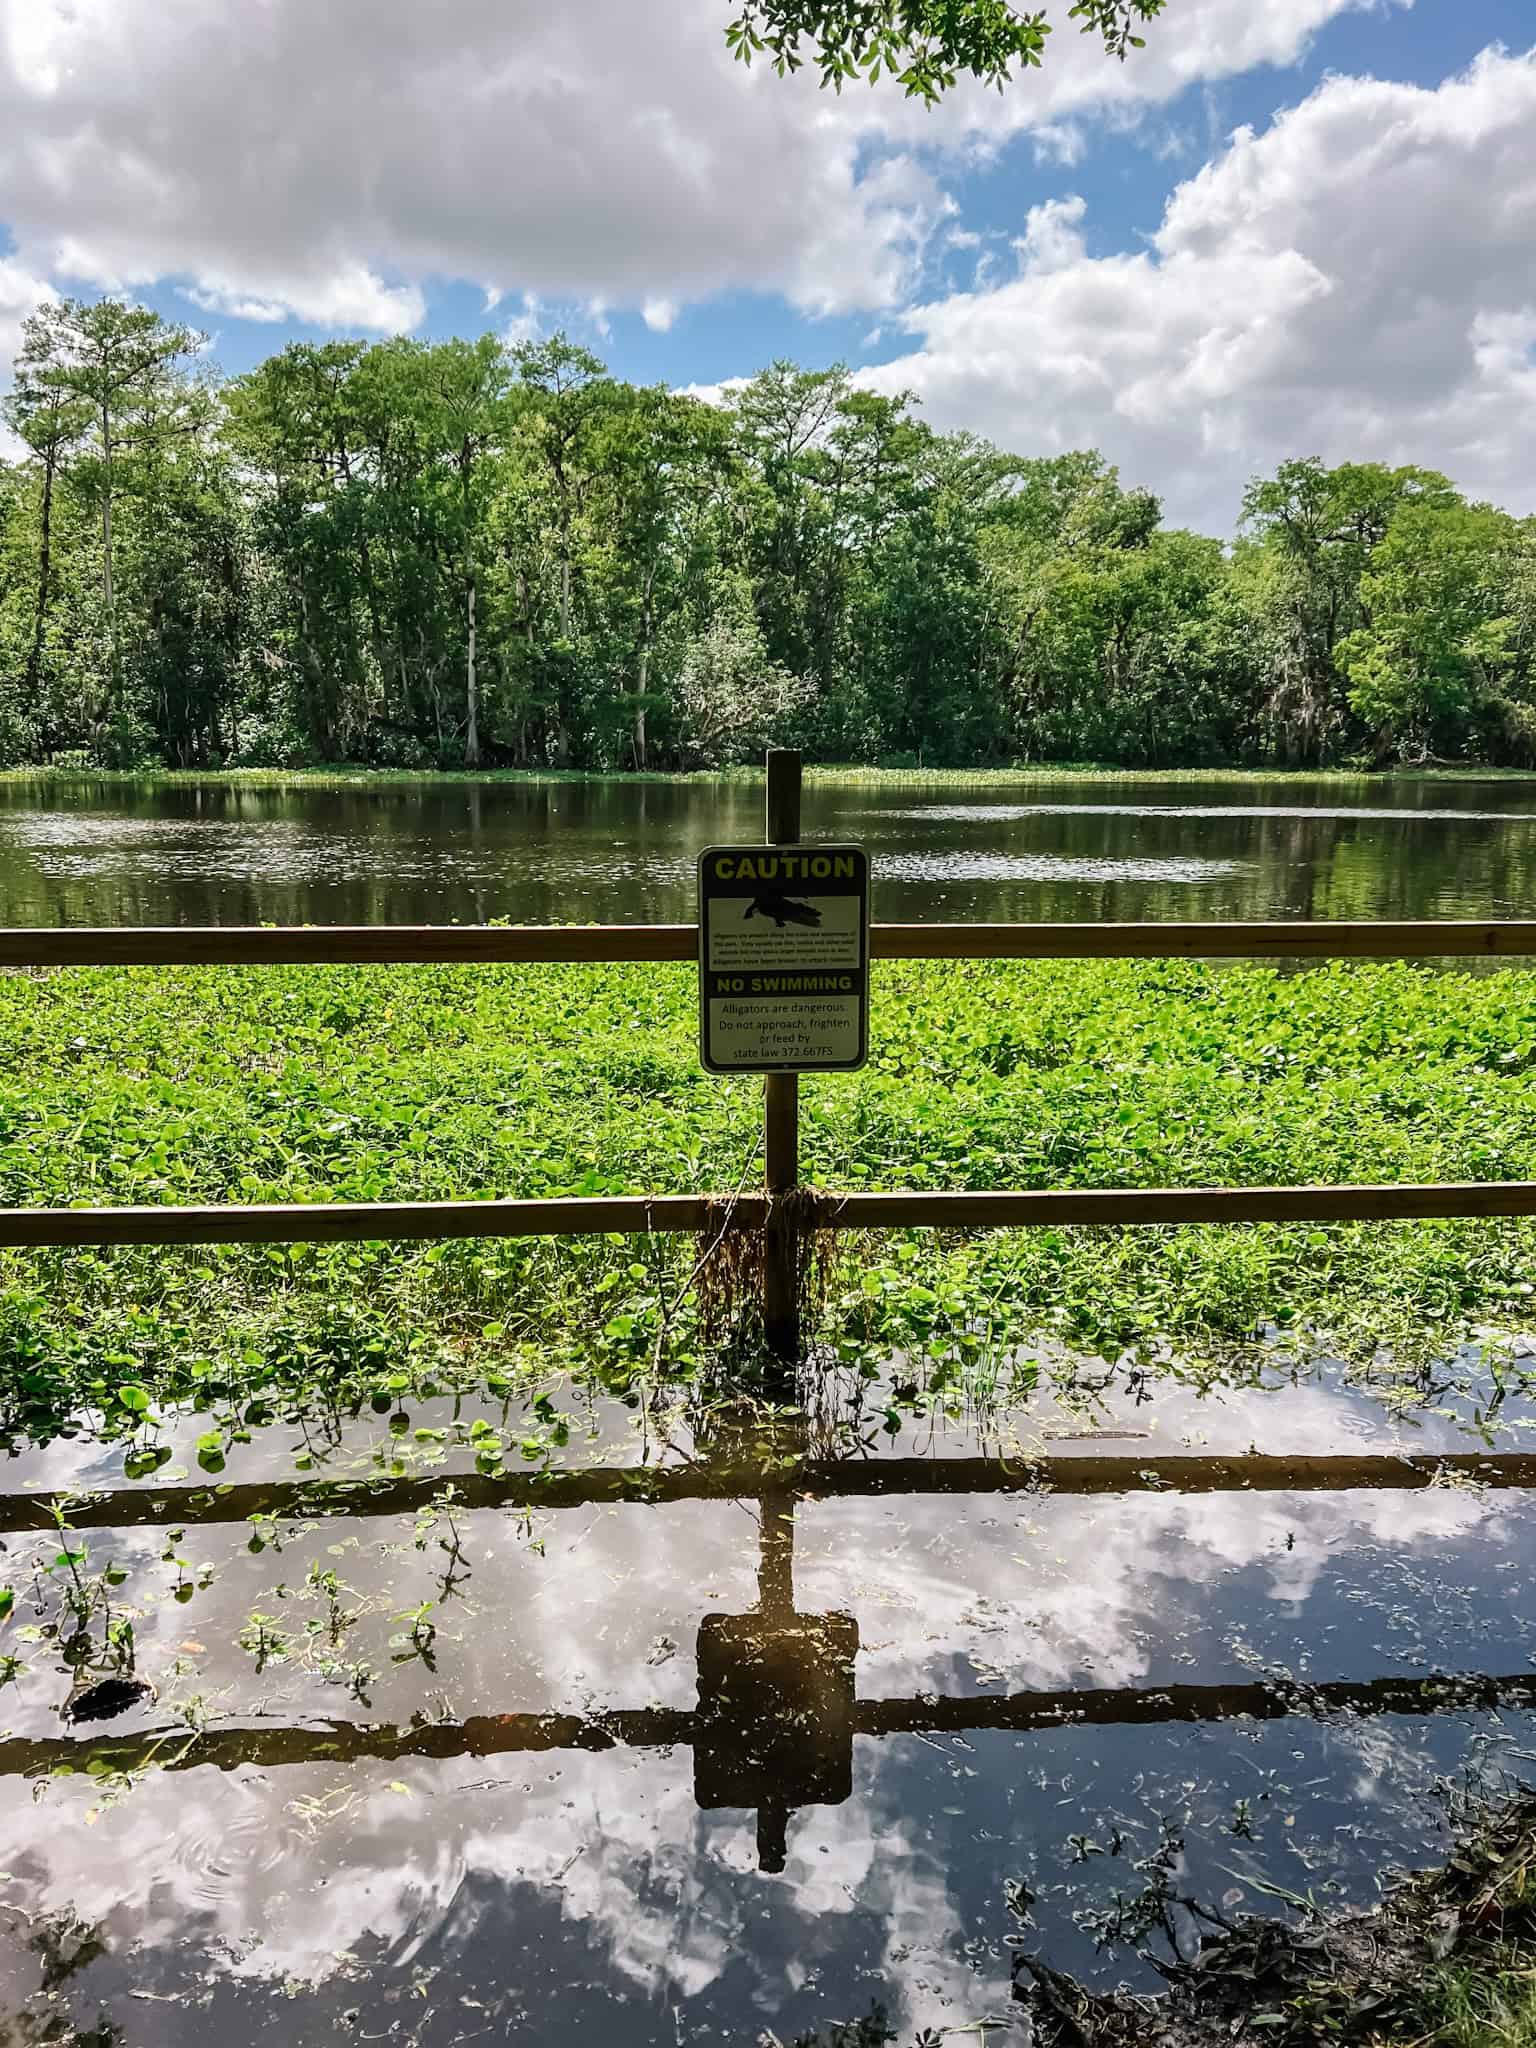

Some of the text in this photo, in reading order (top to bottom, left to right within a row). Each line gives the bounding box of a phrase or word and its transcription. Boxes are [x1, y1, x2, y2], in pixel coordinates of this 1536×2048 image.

[715, 857, 854, 879] CAUTION
[717, 976, 852, 992] NO SWIMMING
[722, 1003, 769, 1016] Alligators
[774, 1005, 789, 1013] are
[720, 1018, 850, 1033] Do not approach, frighten
[760, 1032, 811, 1044] or feed by
[733, 1048, 758, 1058] state
[761, 1047, 779, 1057] law
